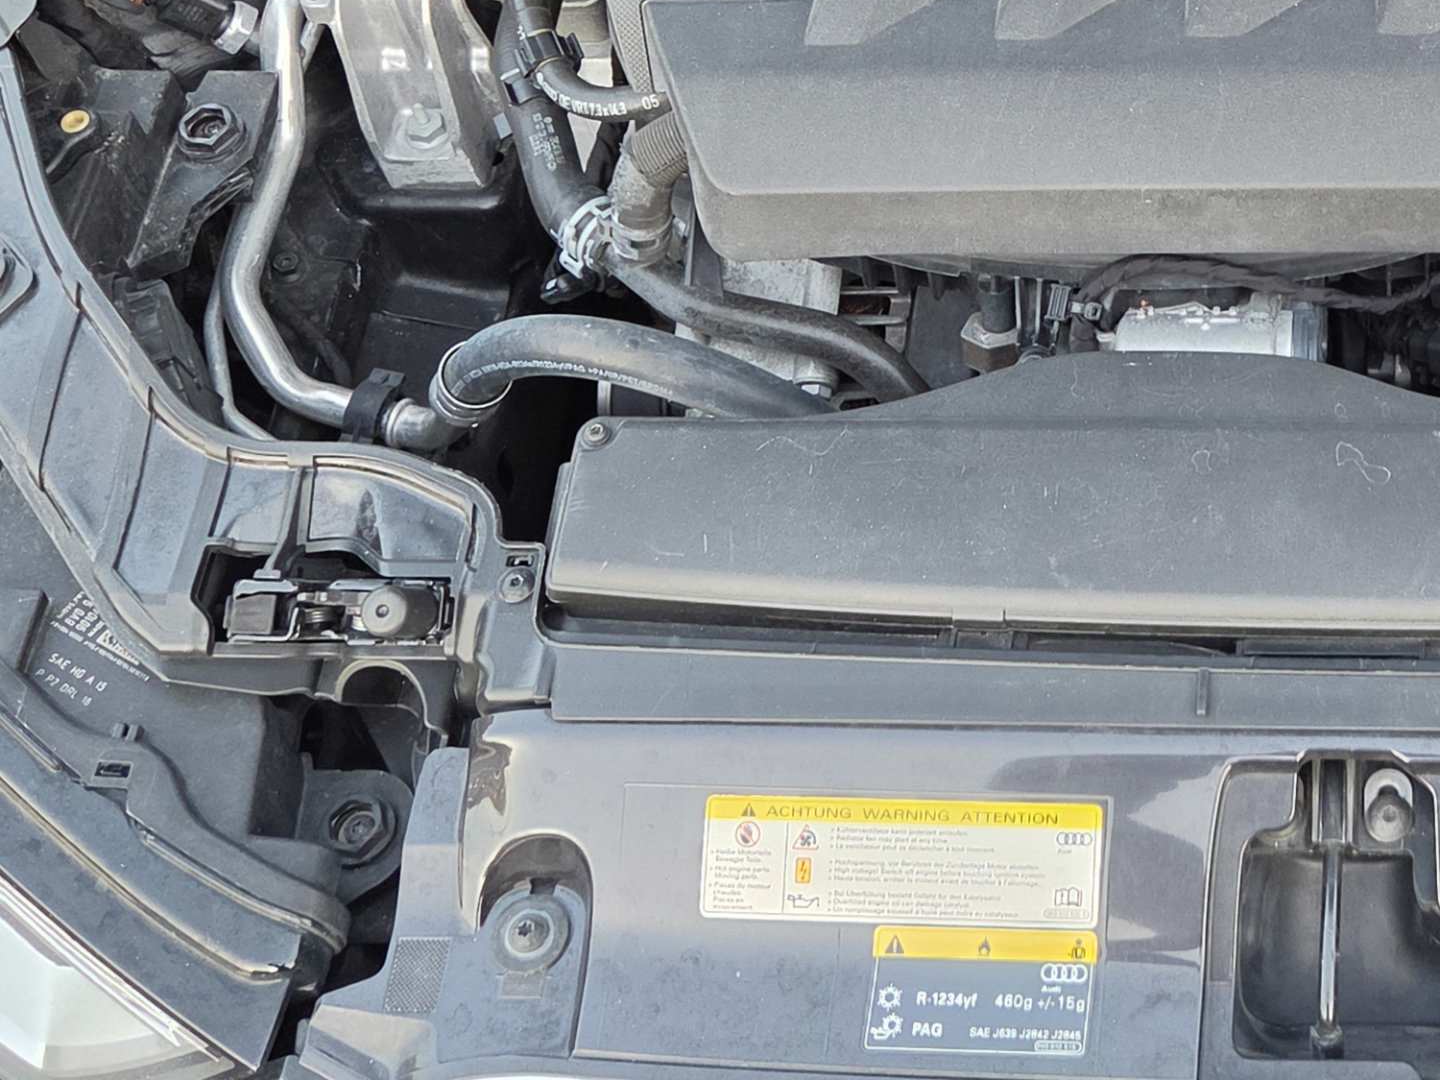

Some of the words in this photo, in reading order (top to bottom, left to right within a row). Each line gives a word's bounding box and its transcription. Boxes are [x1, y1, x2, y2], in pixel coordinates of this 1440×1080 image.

[641, 94, 660, 110] 05
[49, 653, 71, 670] SAE
[85, 674, 95, 685] A
[35, 668, 45, 676] P
[45, 674, 60, 686] P2
[59, 683, 78, 699] DRL
[766, 805, 852, 820] ACHTUNG
[863, 807, 950, 822] WARNING
[961, 809, 1059, 825] ATTENTION
[1041, 985, 1061, 993] Audi
[917, 991, 979, 1010] R-1234yf
[912, 1022, 944, 1037] PAG
[970, 1026, 990, 1038] SAE
[993, 1028, 1017, 1039] J639
